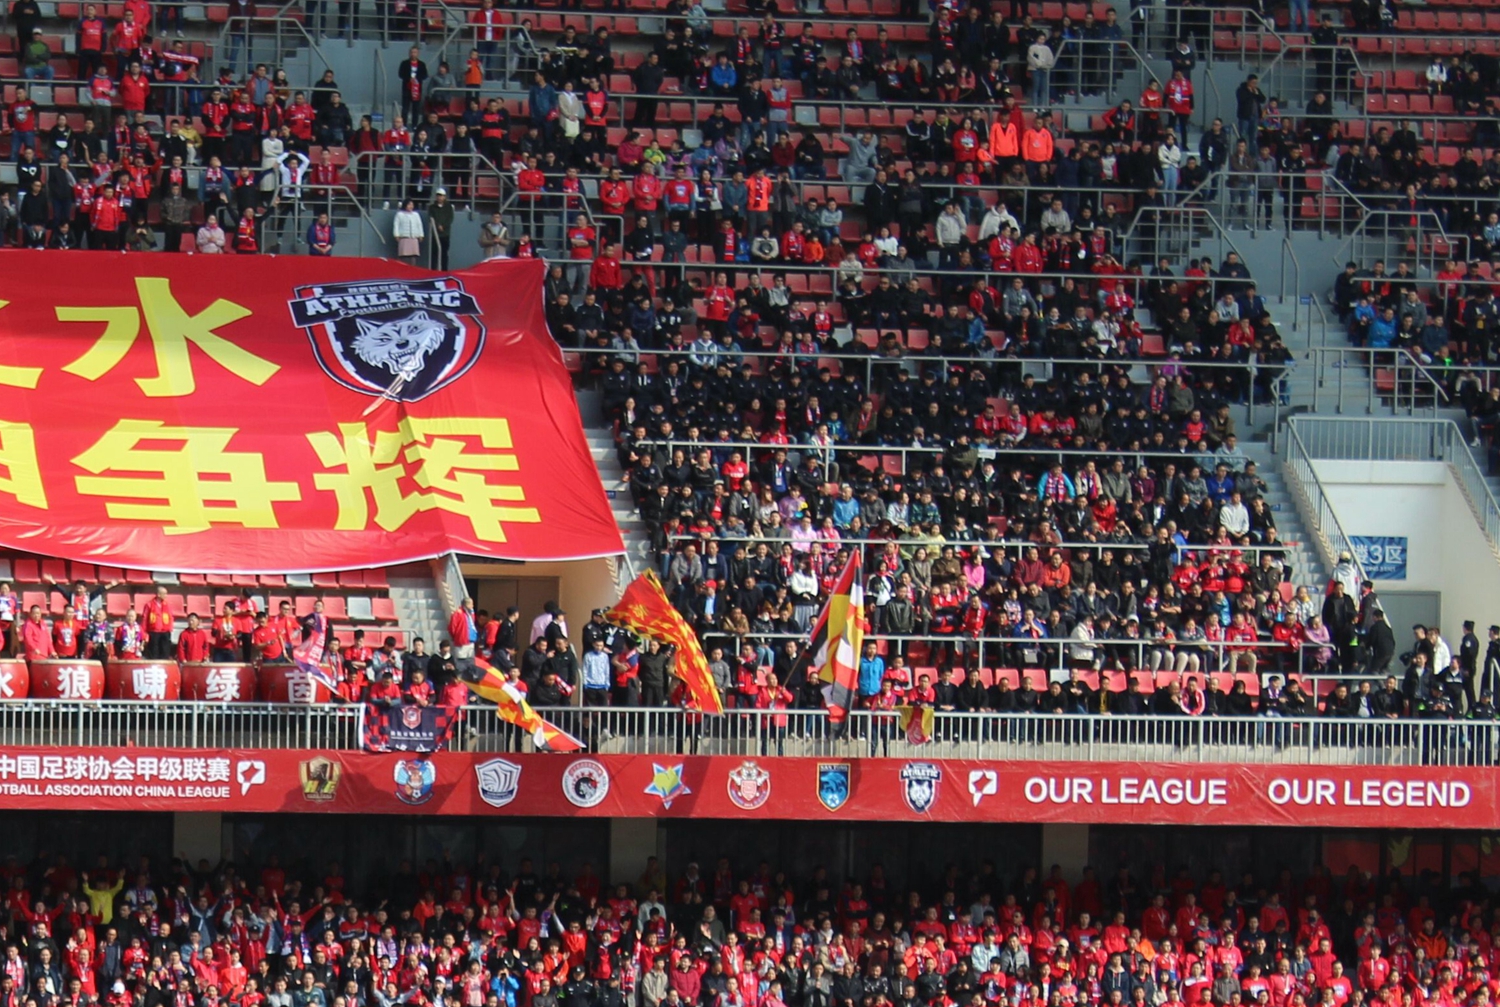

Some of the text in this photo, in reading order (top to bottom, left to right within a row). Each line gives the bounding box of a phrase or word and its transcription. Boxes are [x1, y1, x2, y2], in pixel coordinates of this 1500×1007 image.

[305, 291, 461, 316] ATHLETIC
[45, 784, 132, 797] ASSOCIATION
[135, 785, 176, 797] CHINA
[178, 786, 230, 797] LEAGUE
[1025, 777, 1470, 807] OUR LEAGUE OUR LEGEND
